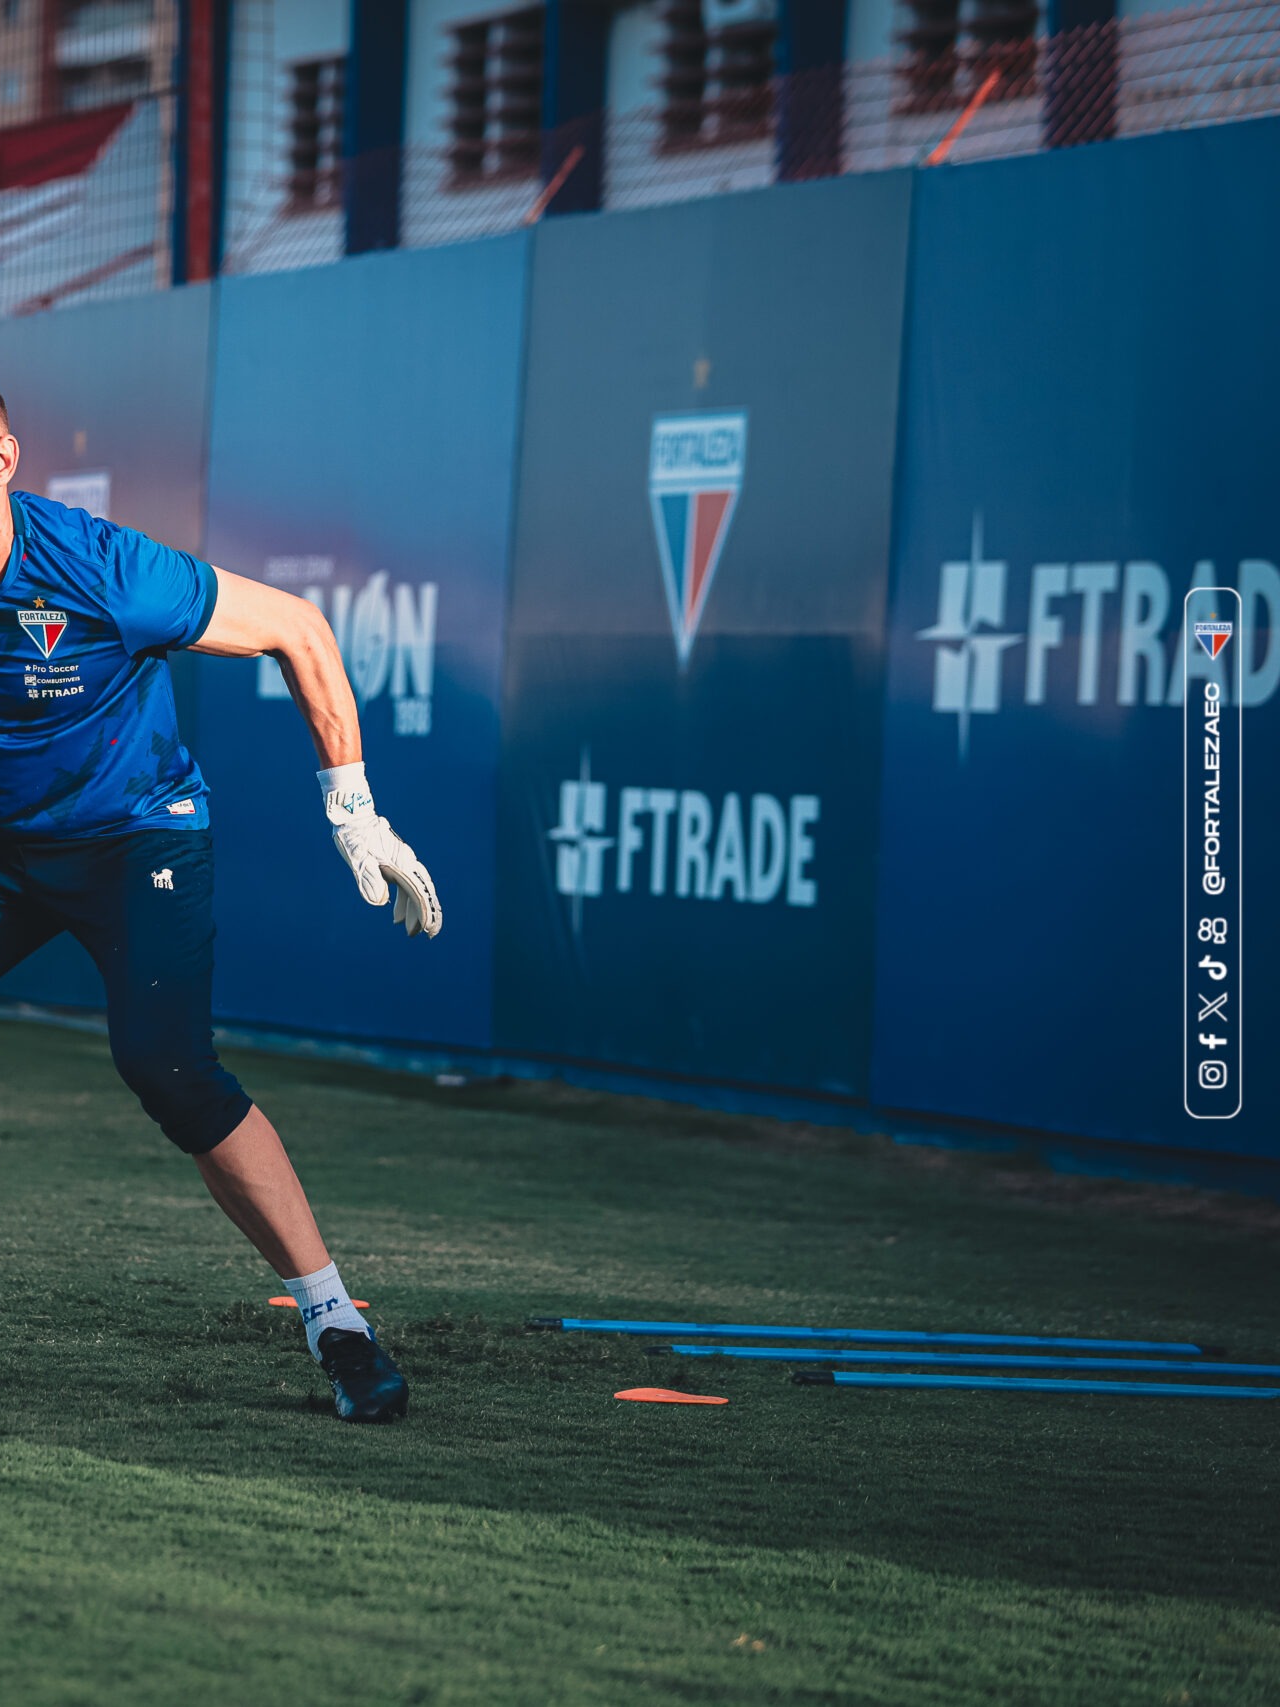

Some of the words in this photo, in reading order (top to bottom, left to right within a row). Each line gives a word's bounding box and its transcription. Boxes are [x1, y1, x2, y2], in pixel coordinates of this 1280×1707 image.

[19, 612, 66, 621] FORTALEZA
[32, 664, 47, 673] Pro
[48, 665, 80, 673] Soccer
[41, 685, 85, 698] FTRADE
[616, 786, 820, 908] FTRADE
